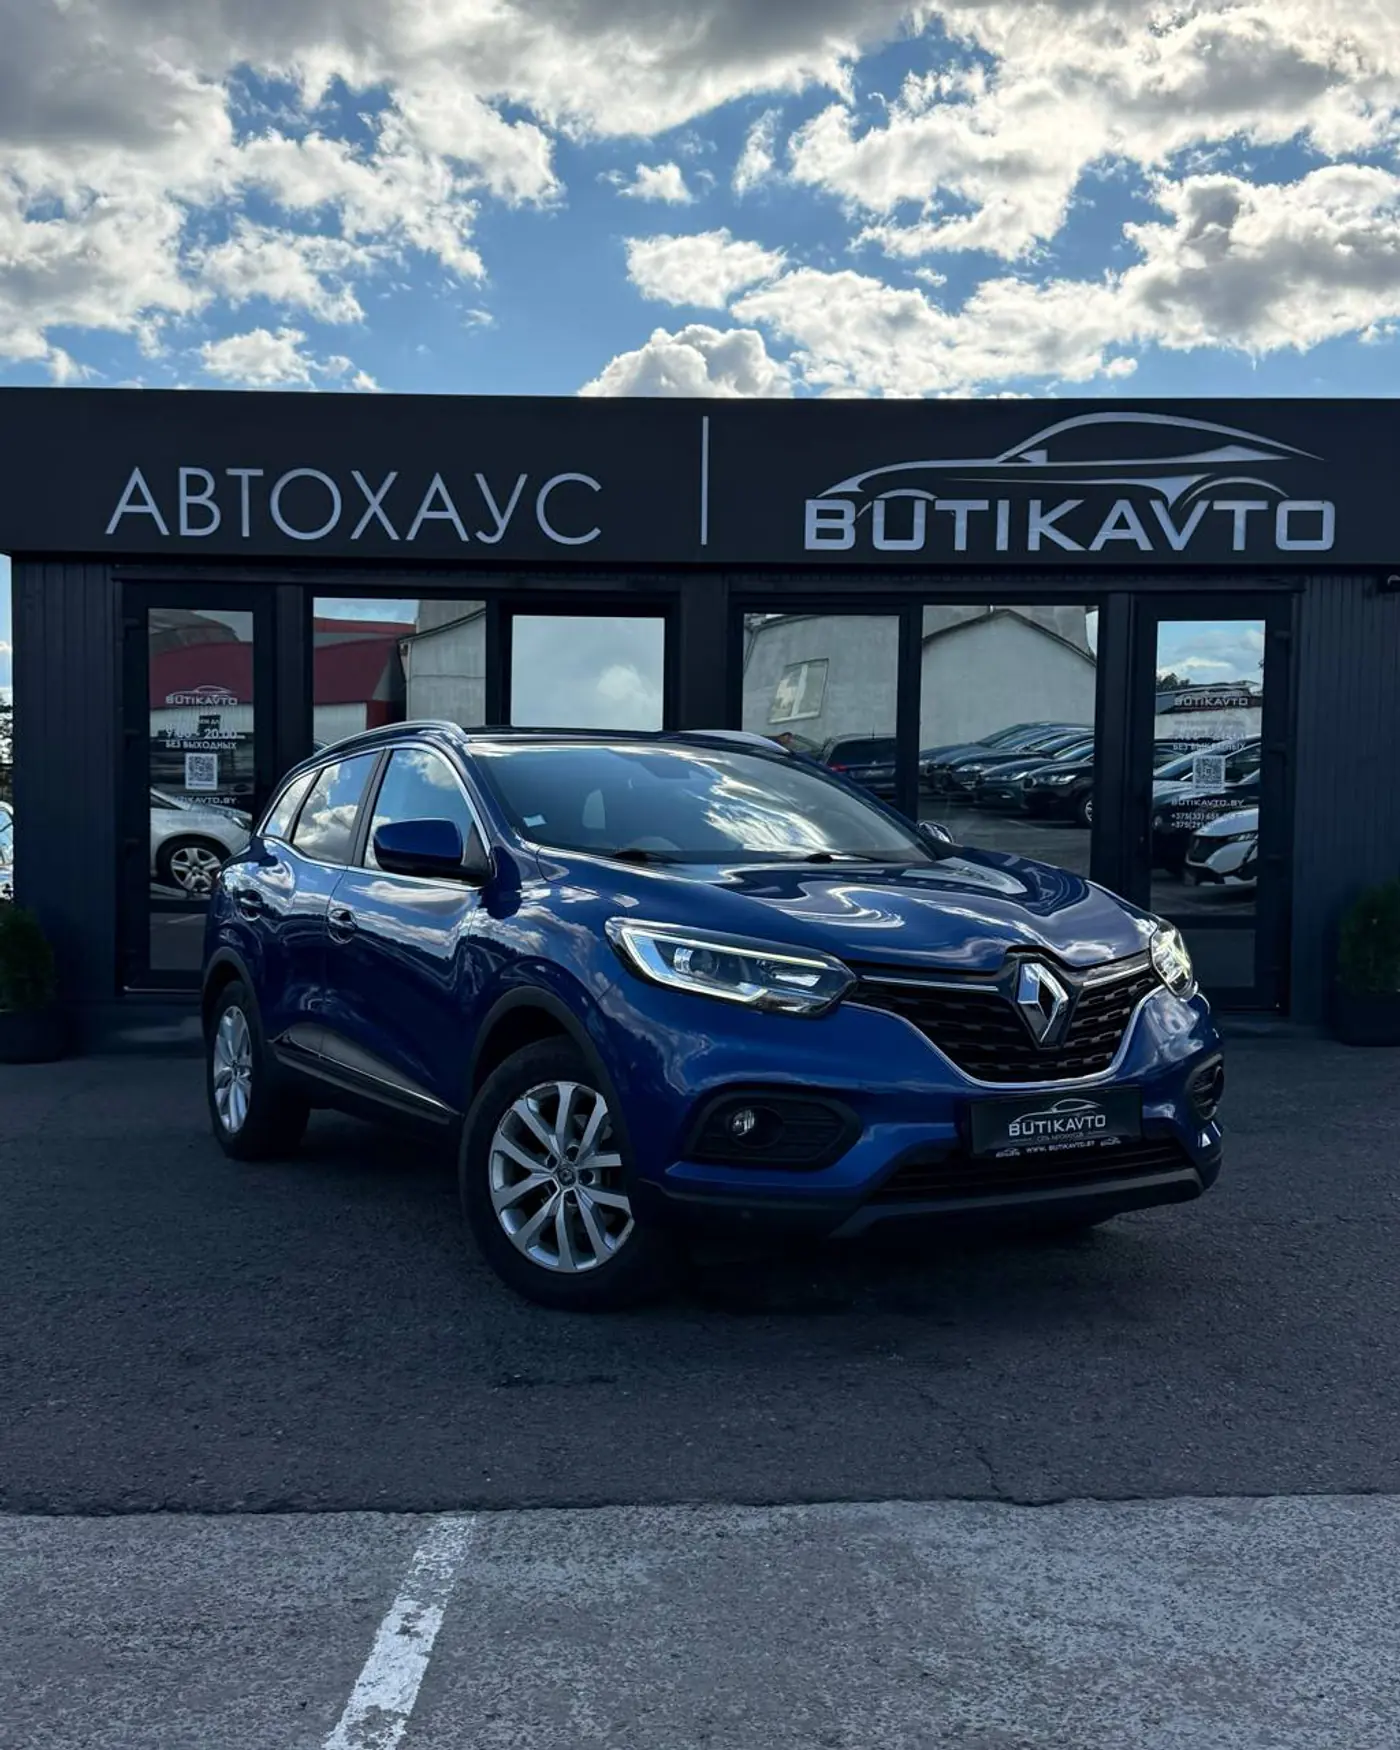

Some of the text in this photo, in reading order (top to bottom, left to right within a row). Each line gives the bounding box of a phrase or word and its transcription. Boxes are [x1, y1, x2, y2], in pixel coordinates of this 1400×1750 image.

[105, 466, 603, 545] АВТОХАУС
[804, 498, 1337, 551] BUTIKAVTO
[165, 694, 238, 706] BUTIKAVTO
[1174, 697, 1249, 706] BUTIKAVTO
[165, 740, 237, 749] БЕЗ ВЫХОДНЫХ
[1171, 799, 1245, 807] BUTIKAVTO.BY
[1009, 1114, 1106, 1136] BUTIKAVTO
